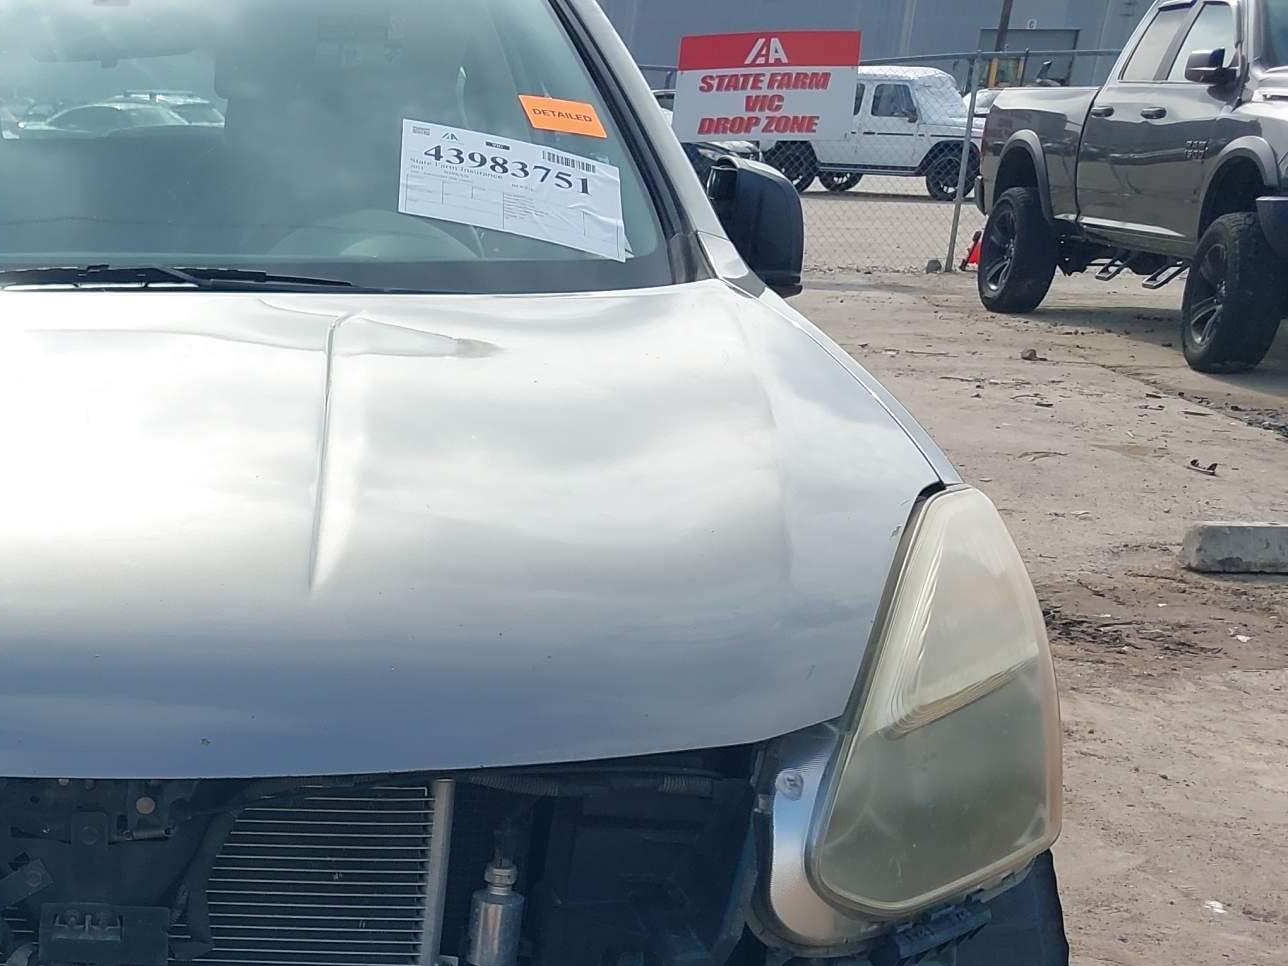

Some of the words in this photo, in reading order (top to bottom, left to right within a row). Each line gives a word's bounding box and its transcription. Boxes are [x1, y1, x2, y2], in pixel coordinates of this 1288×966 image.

[699, 73, 765, 92] STATE
[767, 72, 831, 90] FARM
[745, 94, 784, 112] VIC
[533, 108, 592, 123] DETAILED
[697, 116, 761, 135] DROP
[761, 116, 820, 133] ZONE
[424, 145, 592, 195] 43983751
